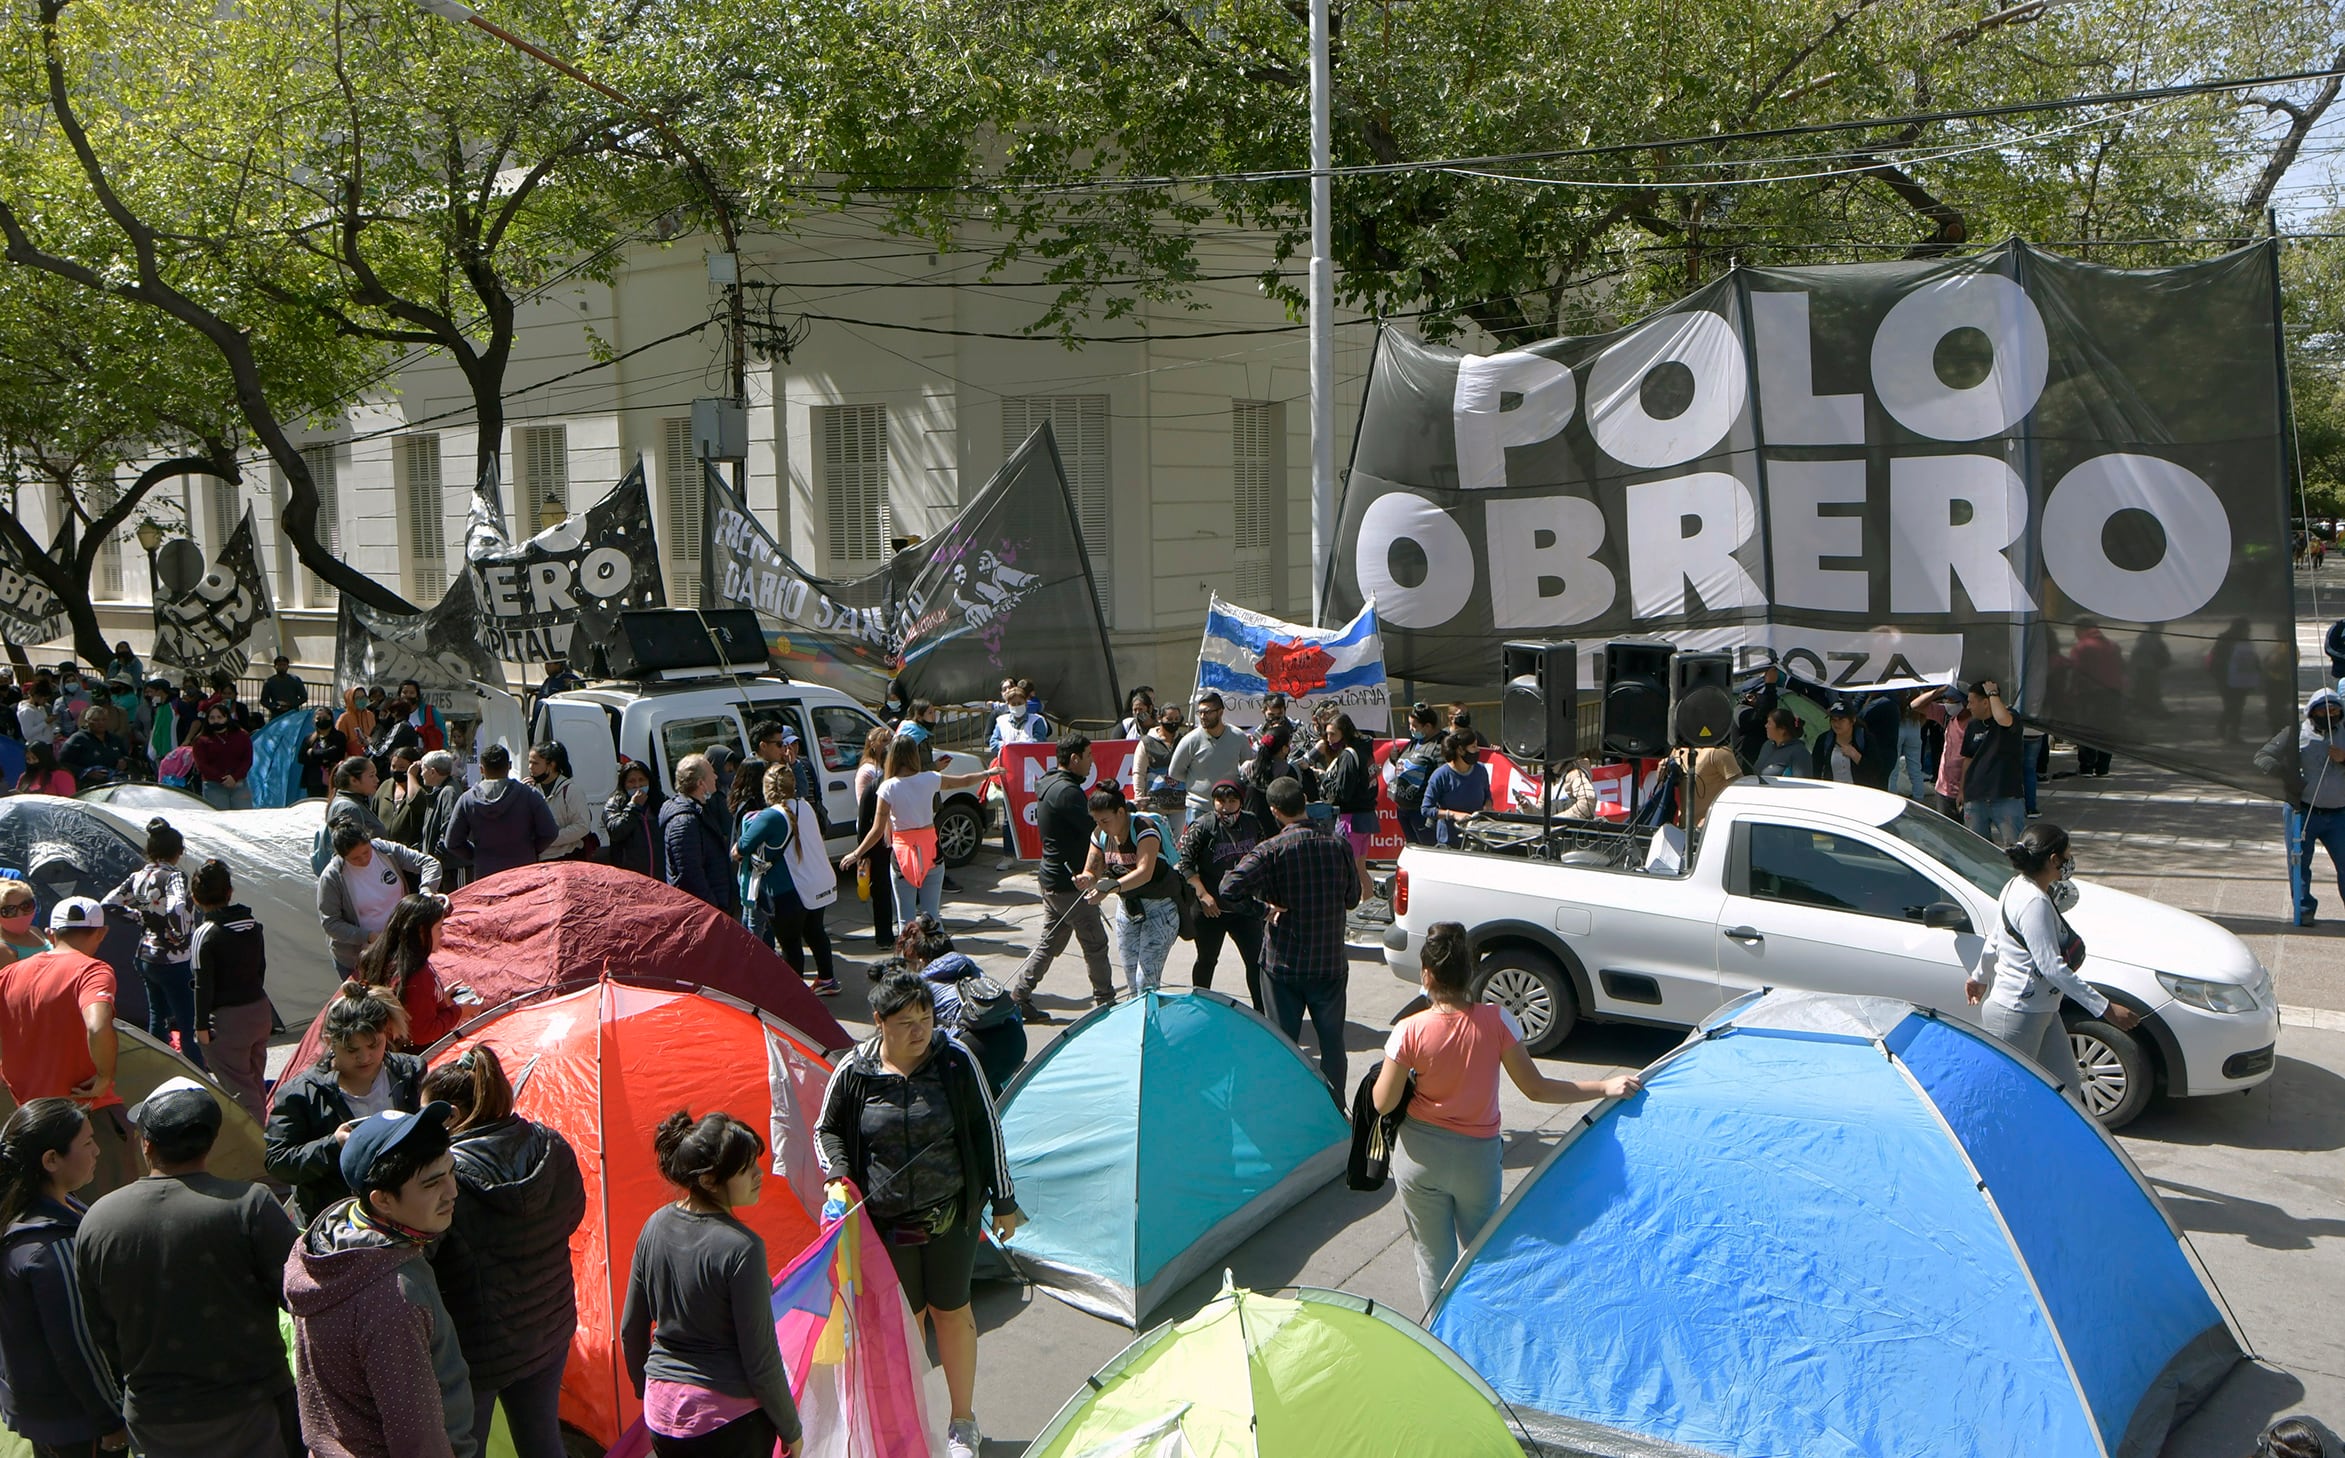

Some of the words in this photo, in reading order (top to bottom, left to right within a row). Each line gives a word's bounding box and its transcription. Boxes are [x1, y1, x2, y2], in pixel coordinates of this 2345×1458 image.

[1454, 273, 2049, 489] POLO
[722, 560, 809, 621] DARIO
[1356, 452, 2232, 629] OBRERO
